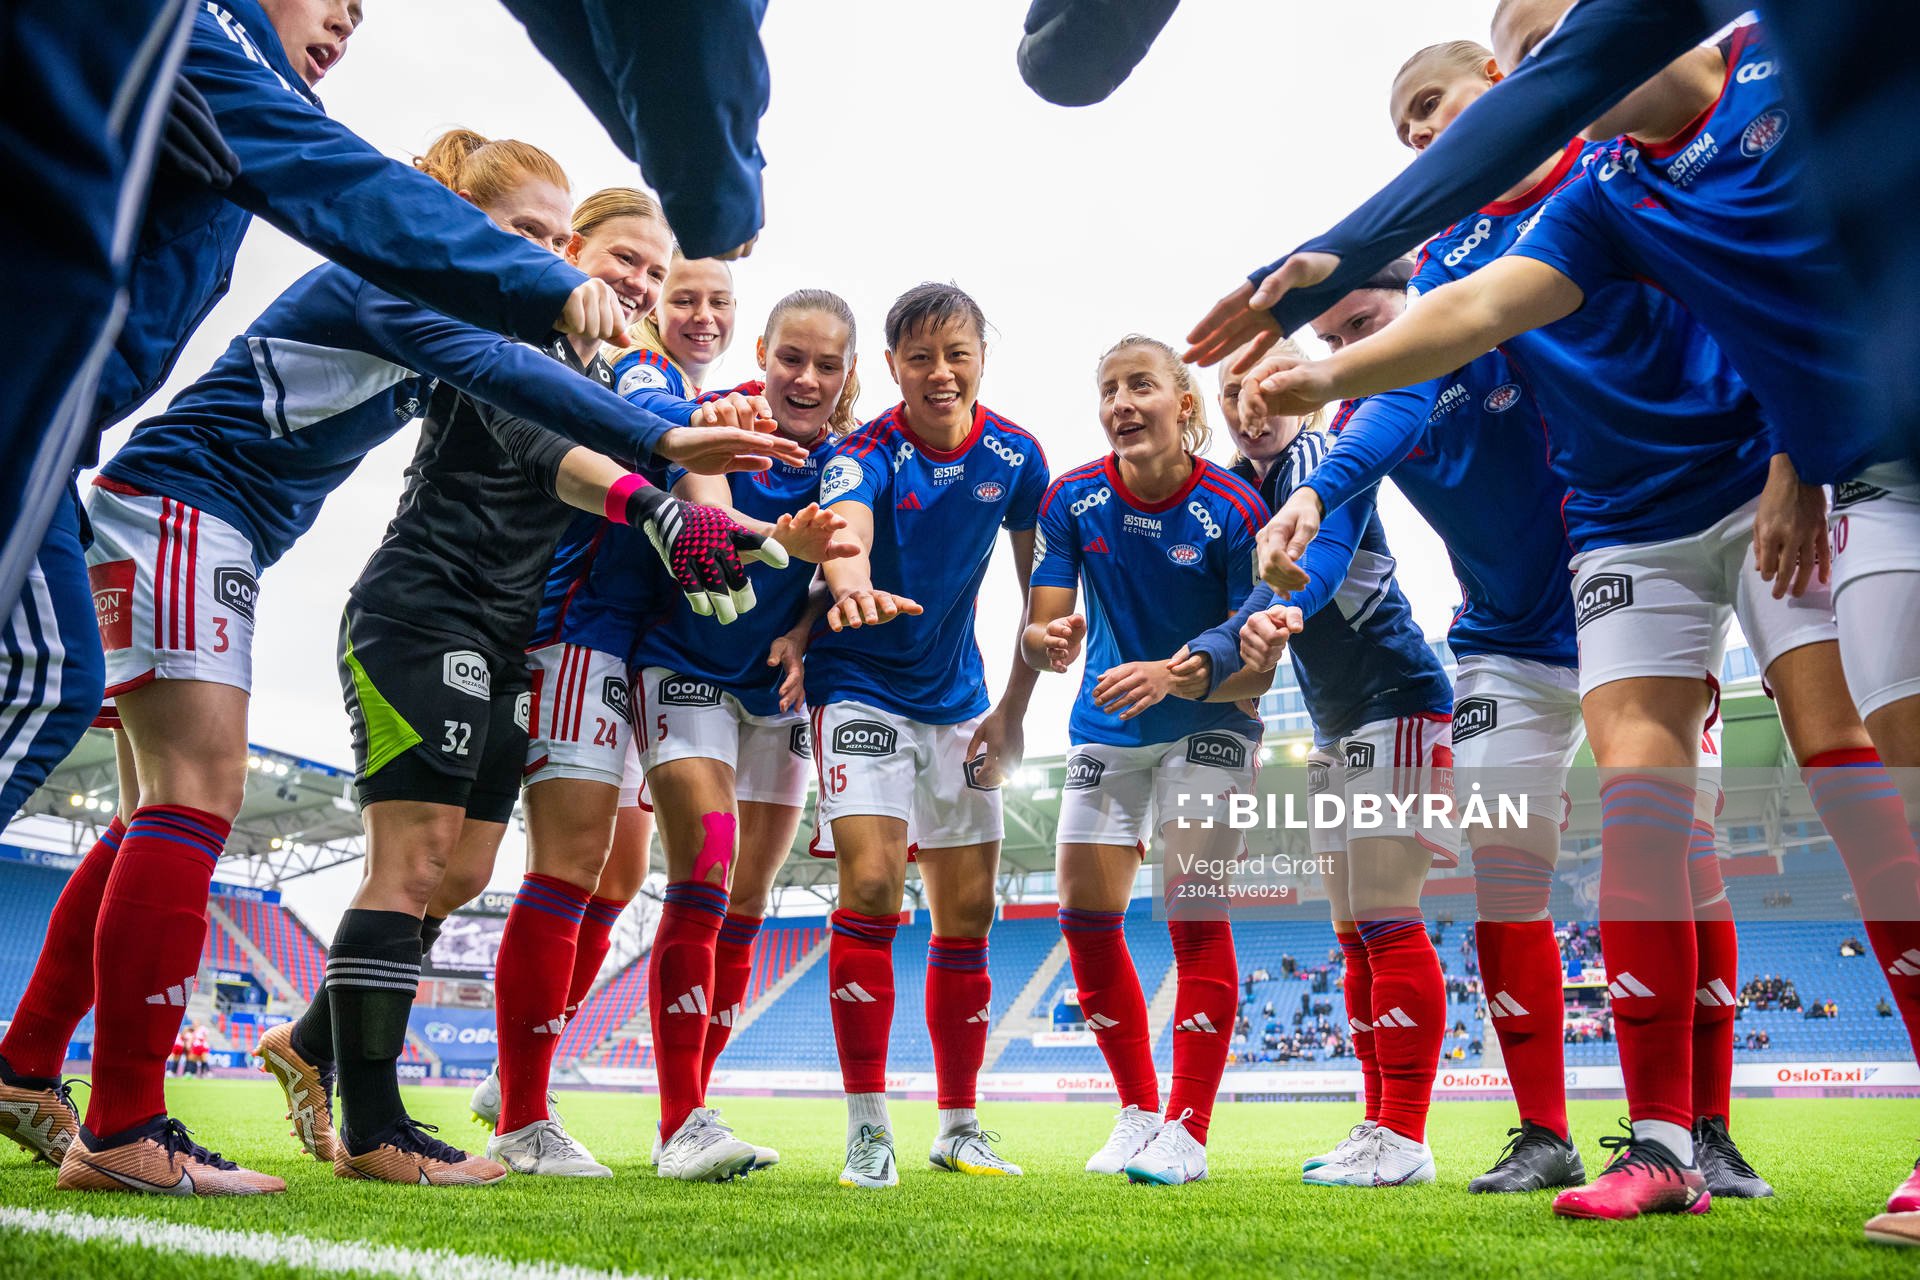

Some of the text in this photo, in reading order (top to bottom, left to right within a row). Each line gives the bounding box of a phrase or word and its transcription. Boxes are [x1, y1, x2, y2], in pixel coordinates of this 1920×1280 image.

[1678, 132, 1716, 173] STENA
[1444, 218, 1491, 266] coop
[983, 435, 1024, 467] coop
[1069, 486, 1111, 517] coop
[1133, 516, 1162, 531] STENA
[1188, 501, 1221, 539] coop
[1123, 526, 1161, 539] RECYCLING
[94, 593, 119, 612] HON
[225, 579, 259, 606] oon
[98, 612, 120, 627] TELS
[212, 617, 229, 653] 3
[455, 662, 490, 684] oon
[667, 682, 715, 698] ooni
[441, 720, 472, 755] 32
[593, 717, 617, 750] 24
[657, 713, 669, 742] 5
[841, 730, 889, 748] ooni
[863, 743, 882, 751] OVENS
[1196, 742, 1239, 762] ooni
[829, 764, 848, 794] 15
[1443, 1074, 1509, 1087] OsloTax
[1777, 1068, 1861, 1083] OsloTaxi
